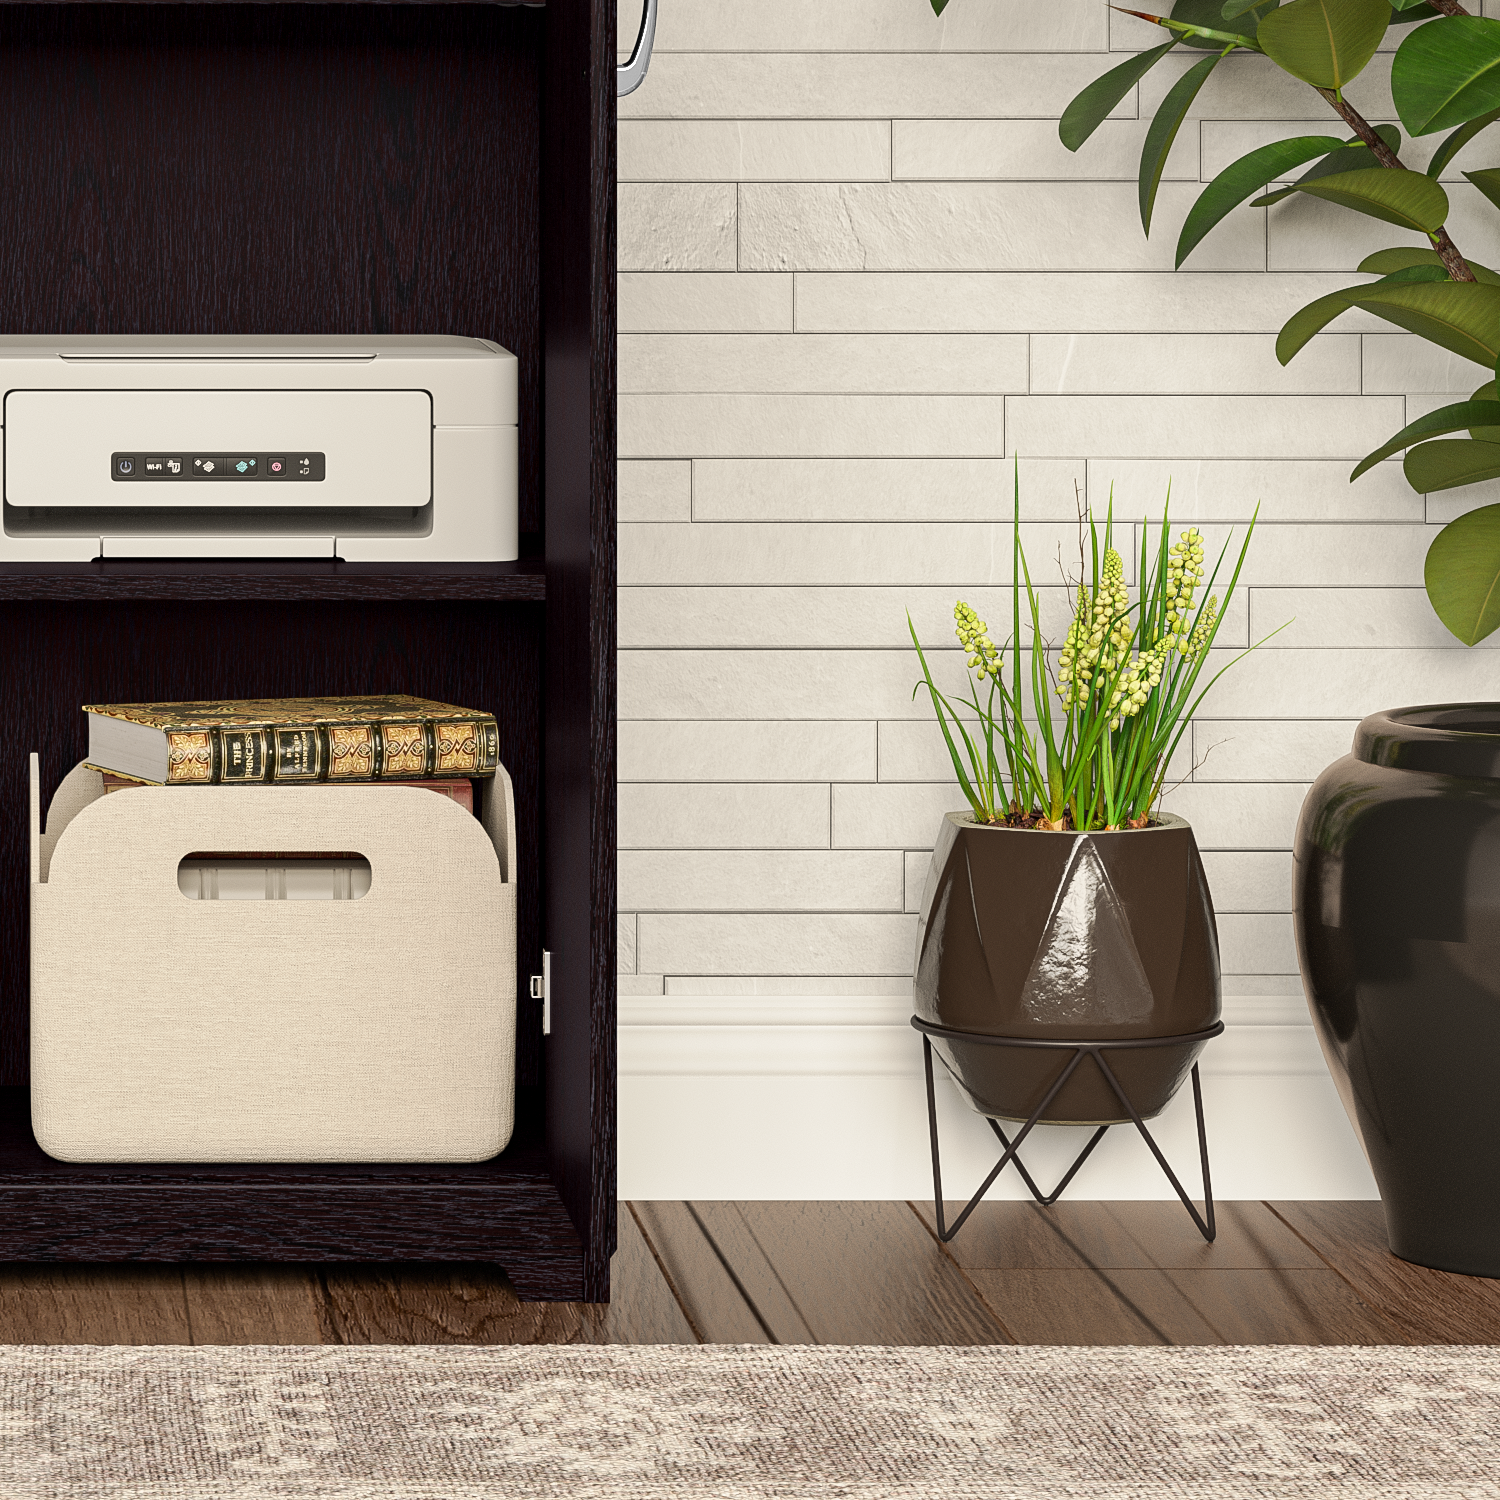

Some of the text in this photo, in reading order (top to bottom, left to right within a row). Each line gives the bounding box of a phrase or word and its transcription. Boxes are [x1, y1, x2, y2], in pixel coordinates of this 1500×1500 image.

[233, 741, 242, 766] THE
[244, 732, 254, 778] PRINCESS
[286, 747, 292, 758] BY
[293, 734, 301, 770] ALFRED
